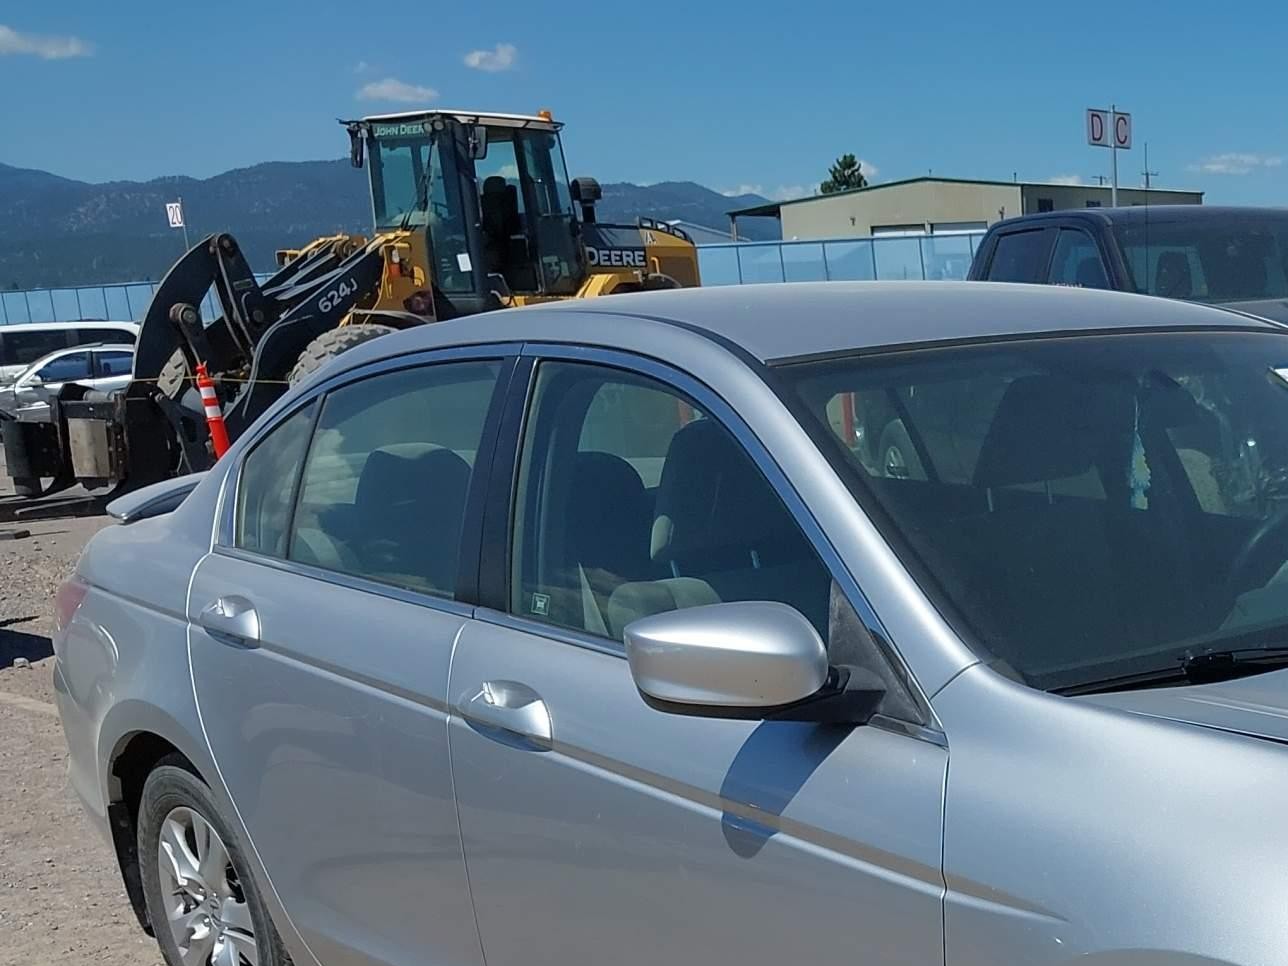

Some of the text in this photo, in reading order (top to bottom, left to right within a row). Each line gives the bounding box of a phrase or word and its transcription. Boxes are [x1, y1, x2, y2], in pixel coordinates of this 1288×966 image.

[374, 126, 399, 137] JOHN
[1091, 113, 1104, 142] D
[1115, 116, 1128, 145] C
[168, 205, 183, 225] 20
[585, 246, 646, 266] DEERE
[318, 277, 358, 312] 624J
